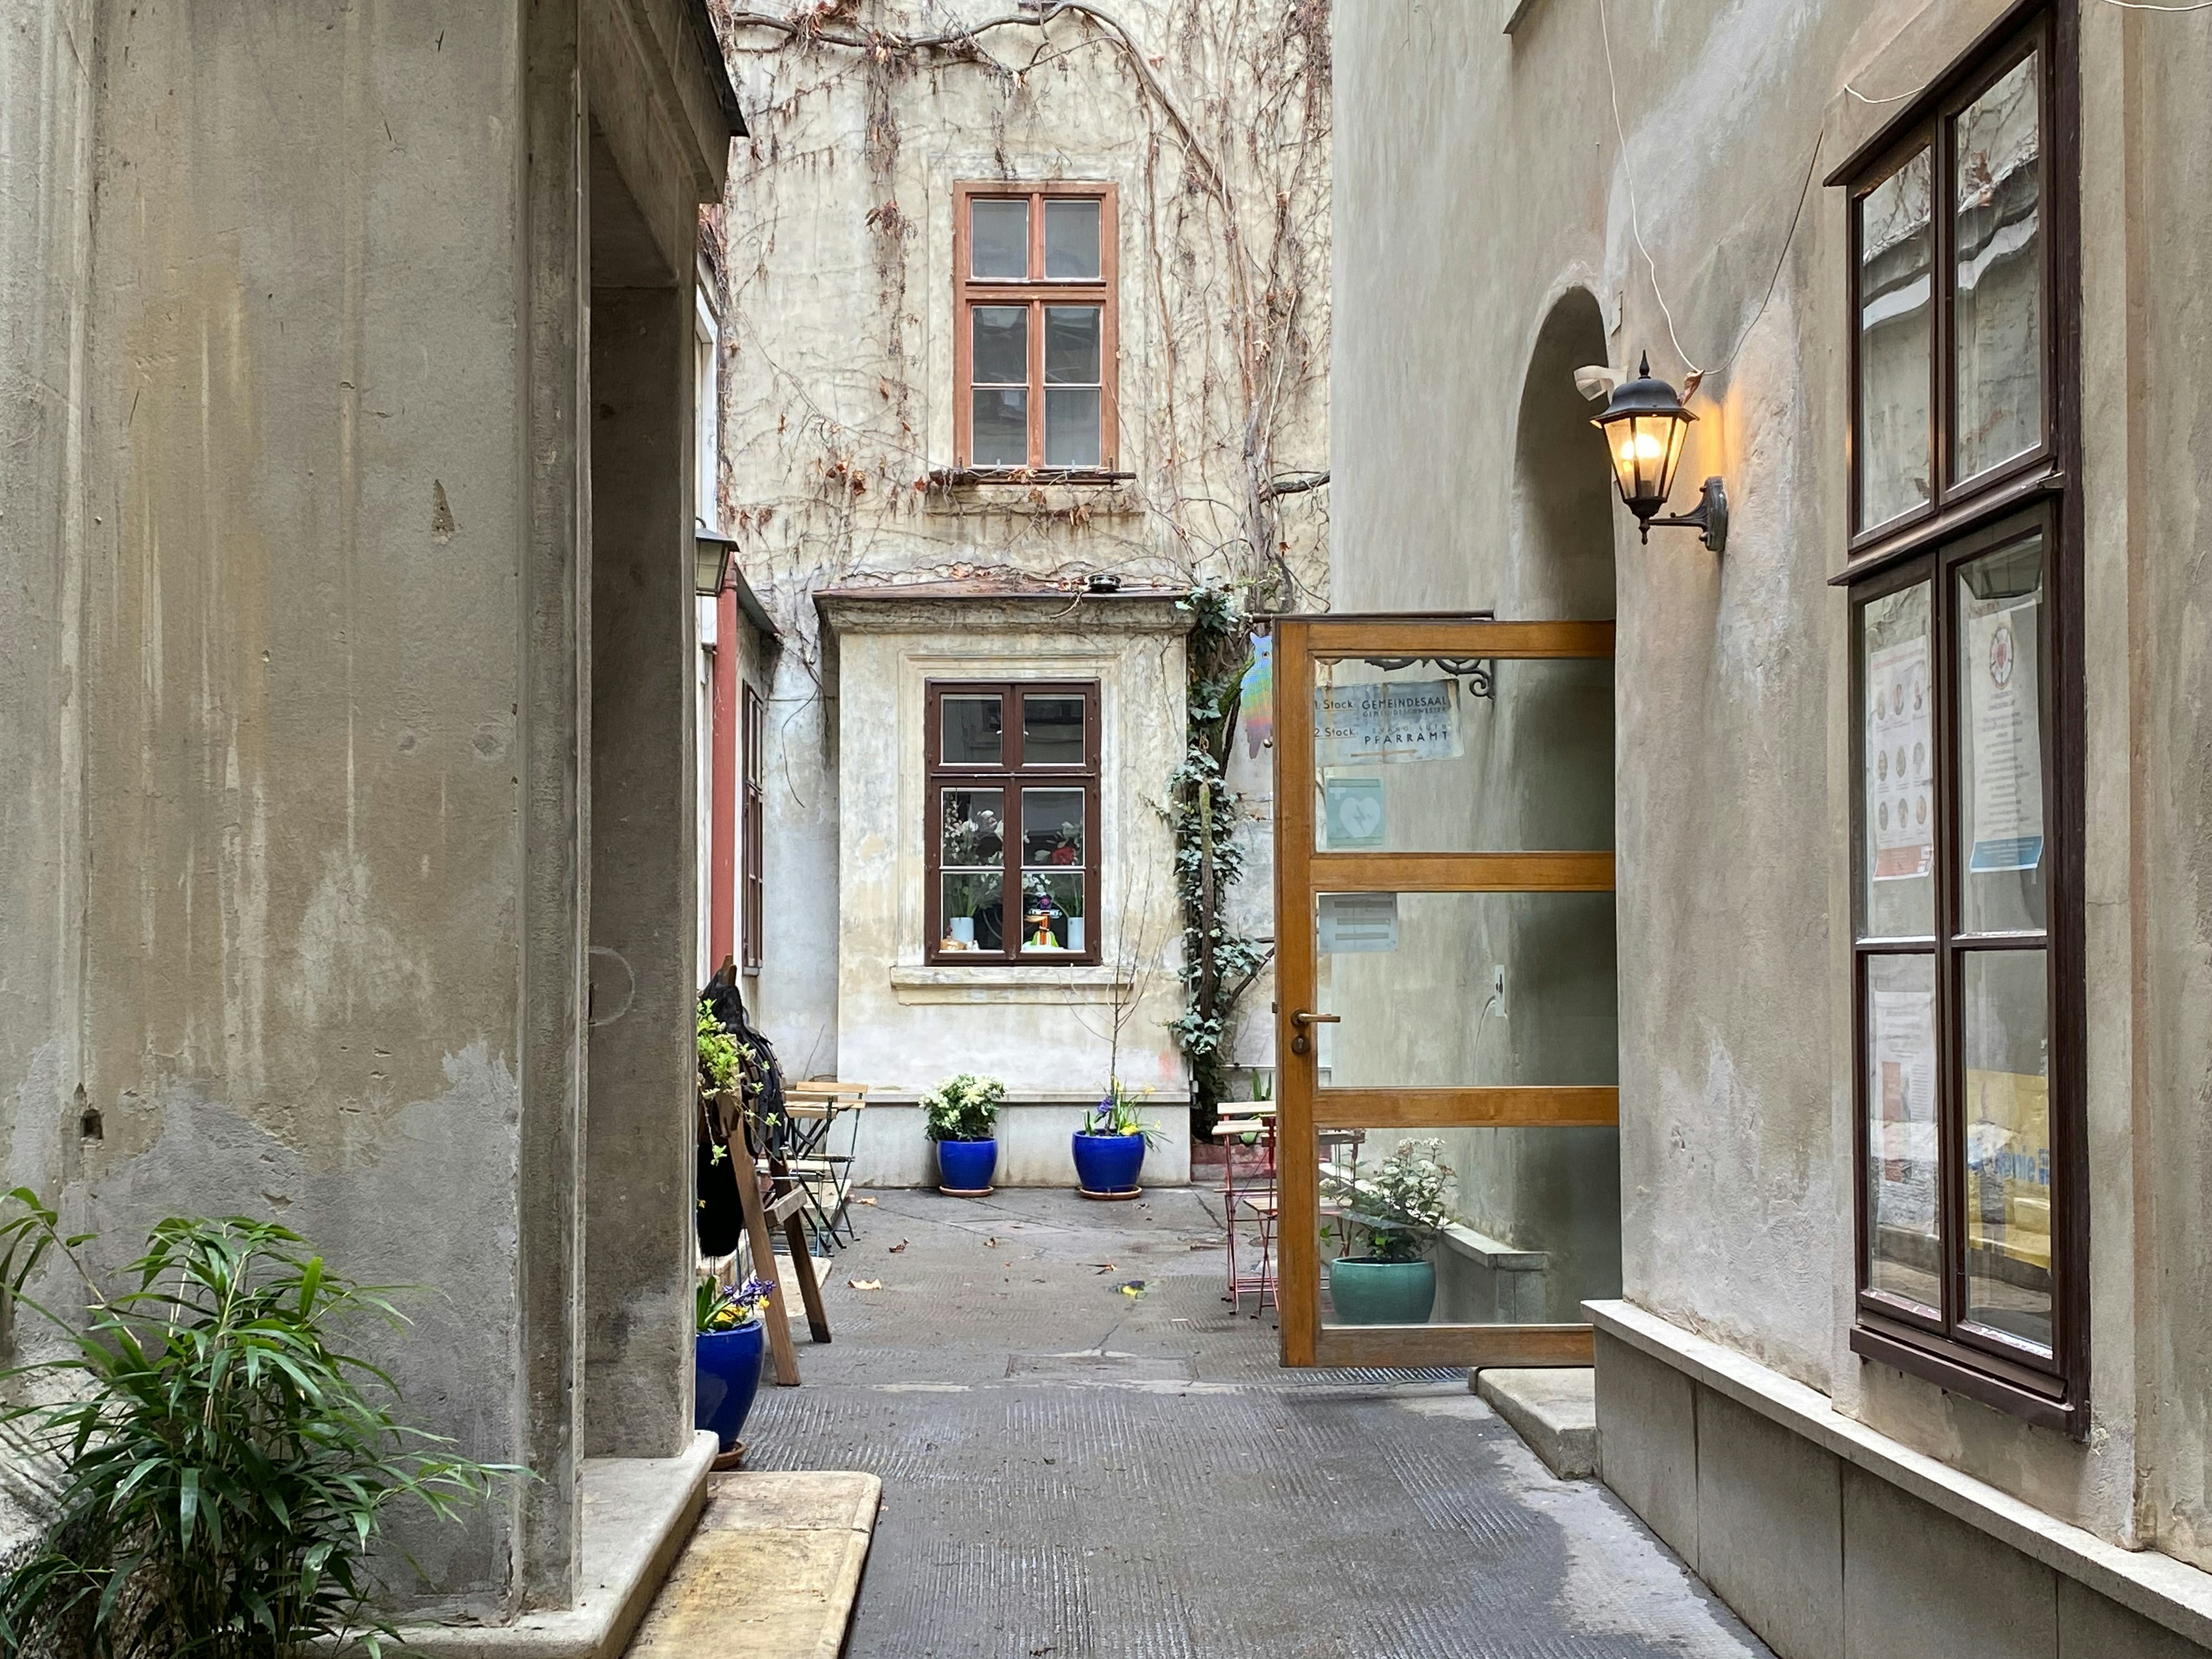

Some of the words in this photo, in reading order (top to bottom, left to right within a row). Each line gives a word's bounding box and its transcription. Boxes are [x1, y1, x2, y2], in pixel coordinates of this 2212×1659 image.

[1323, 699, 1353, 709] Stock
[1362, 696, 1447, 710] GEMEINDESAAL
[1314, 727, 1320, 737] 2
[1325, 727, 1356, 737] Stock
[1364, 731, 1447, 746] PFARRAMT
